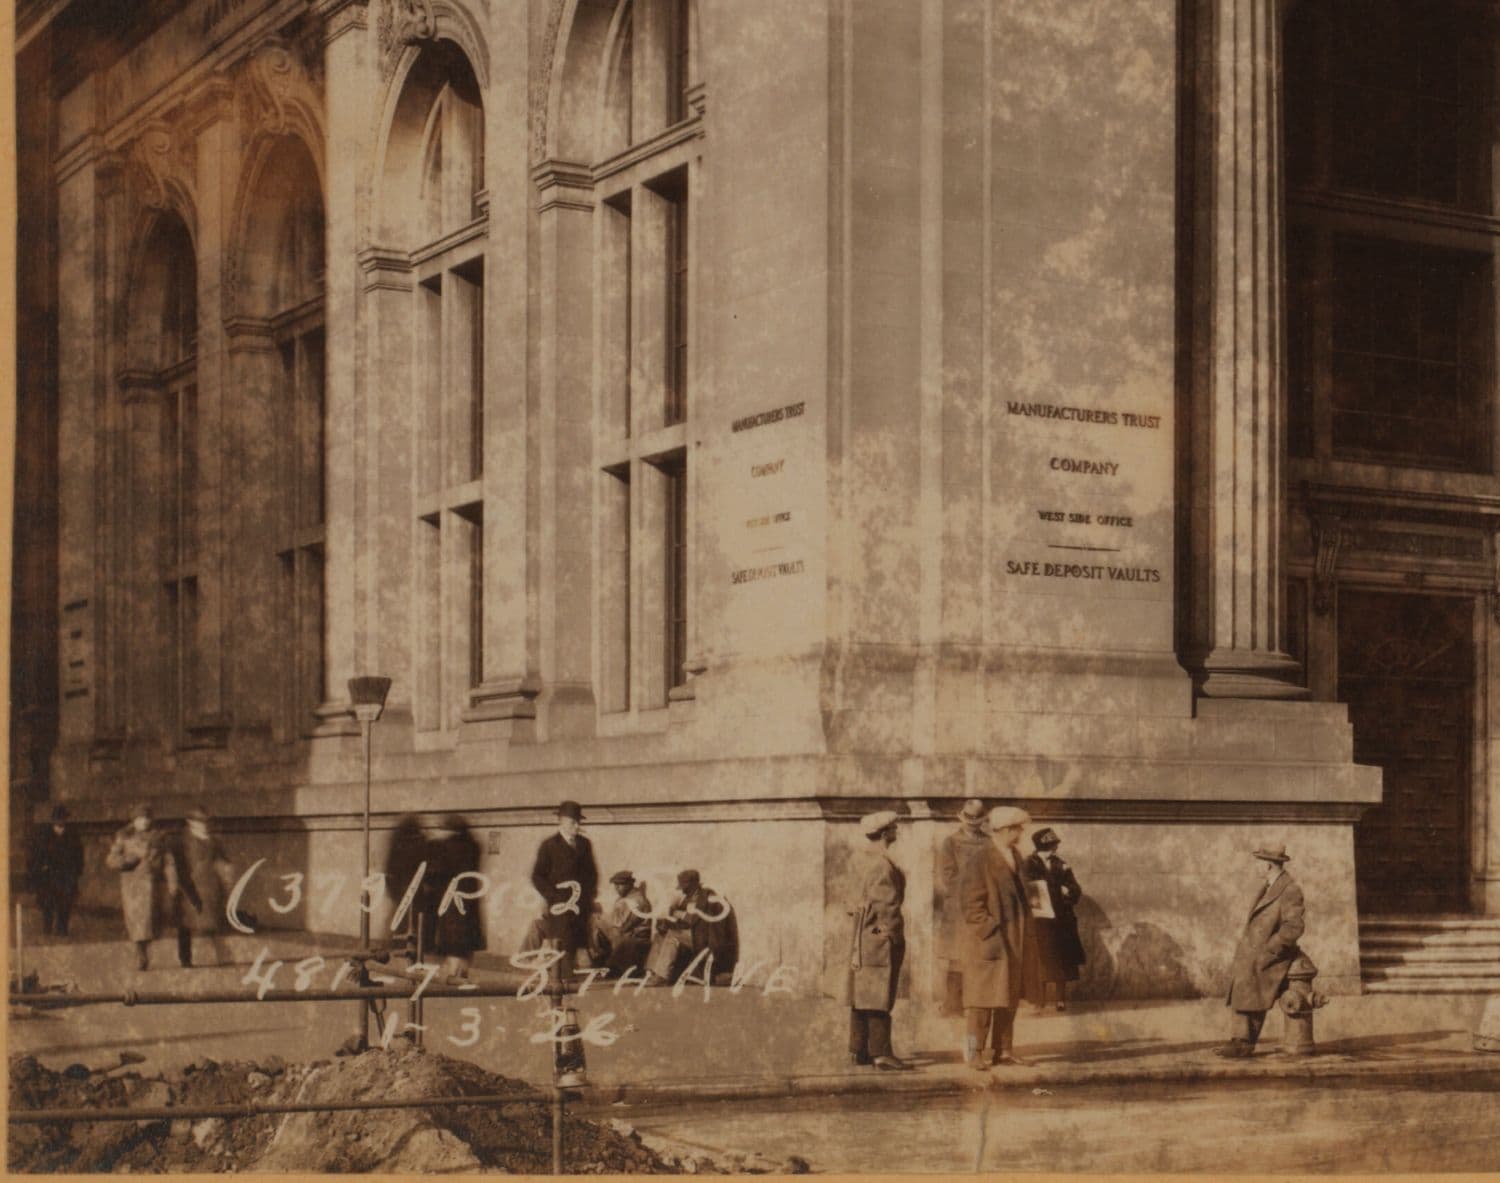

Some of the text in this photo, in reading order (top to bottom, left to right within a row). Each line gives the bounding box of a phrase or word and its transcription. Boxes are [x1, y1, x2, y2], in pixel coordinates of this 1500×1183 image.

[1006, 401, 1161, 429] MANUFACTURERS TRUST
[1050, 457, 1119, 476] COMPANY
[1038, 510, 1134, 527] WEST SIDE OFFICE
[1006, 560, 1161, 584] SAFE DEPOSIT VAULTS
